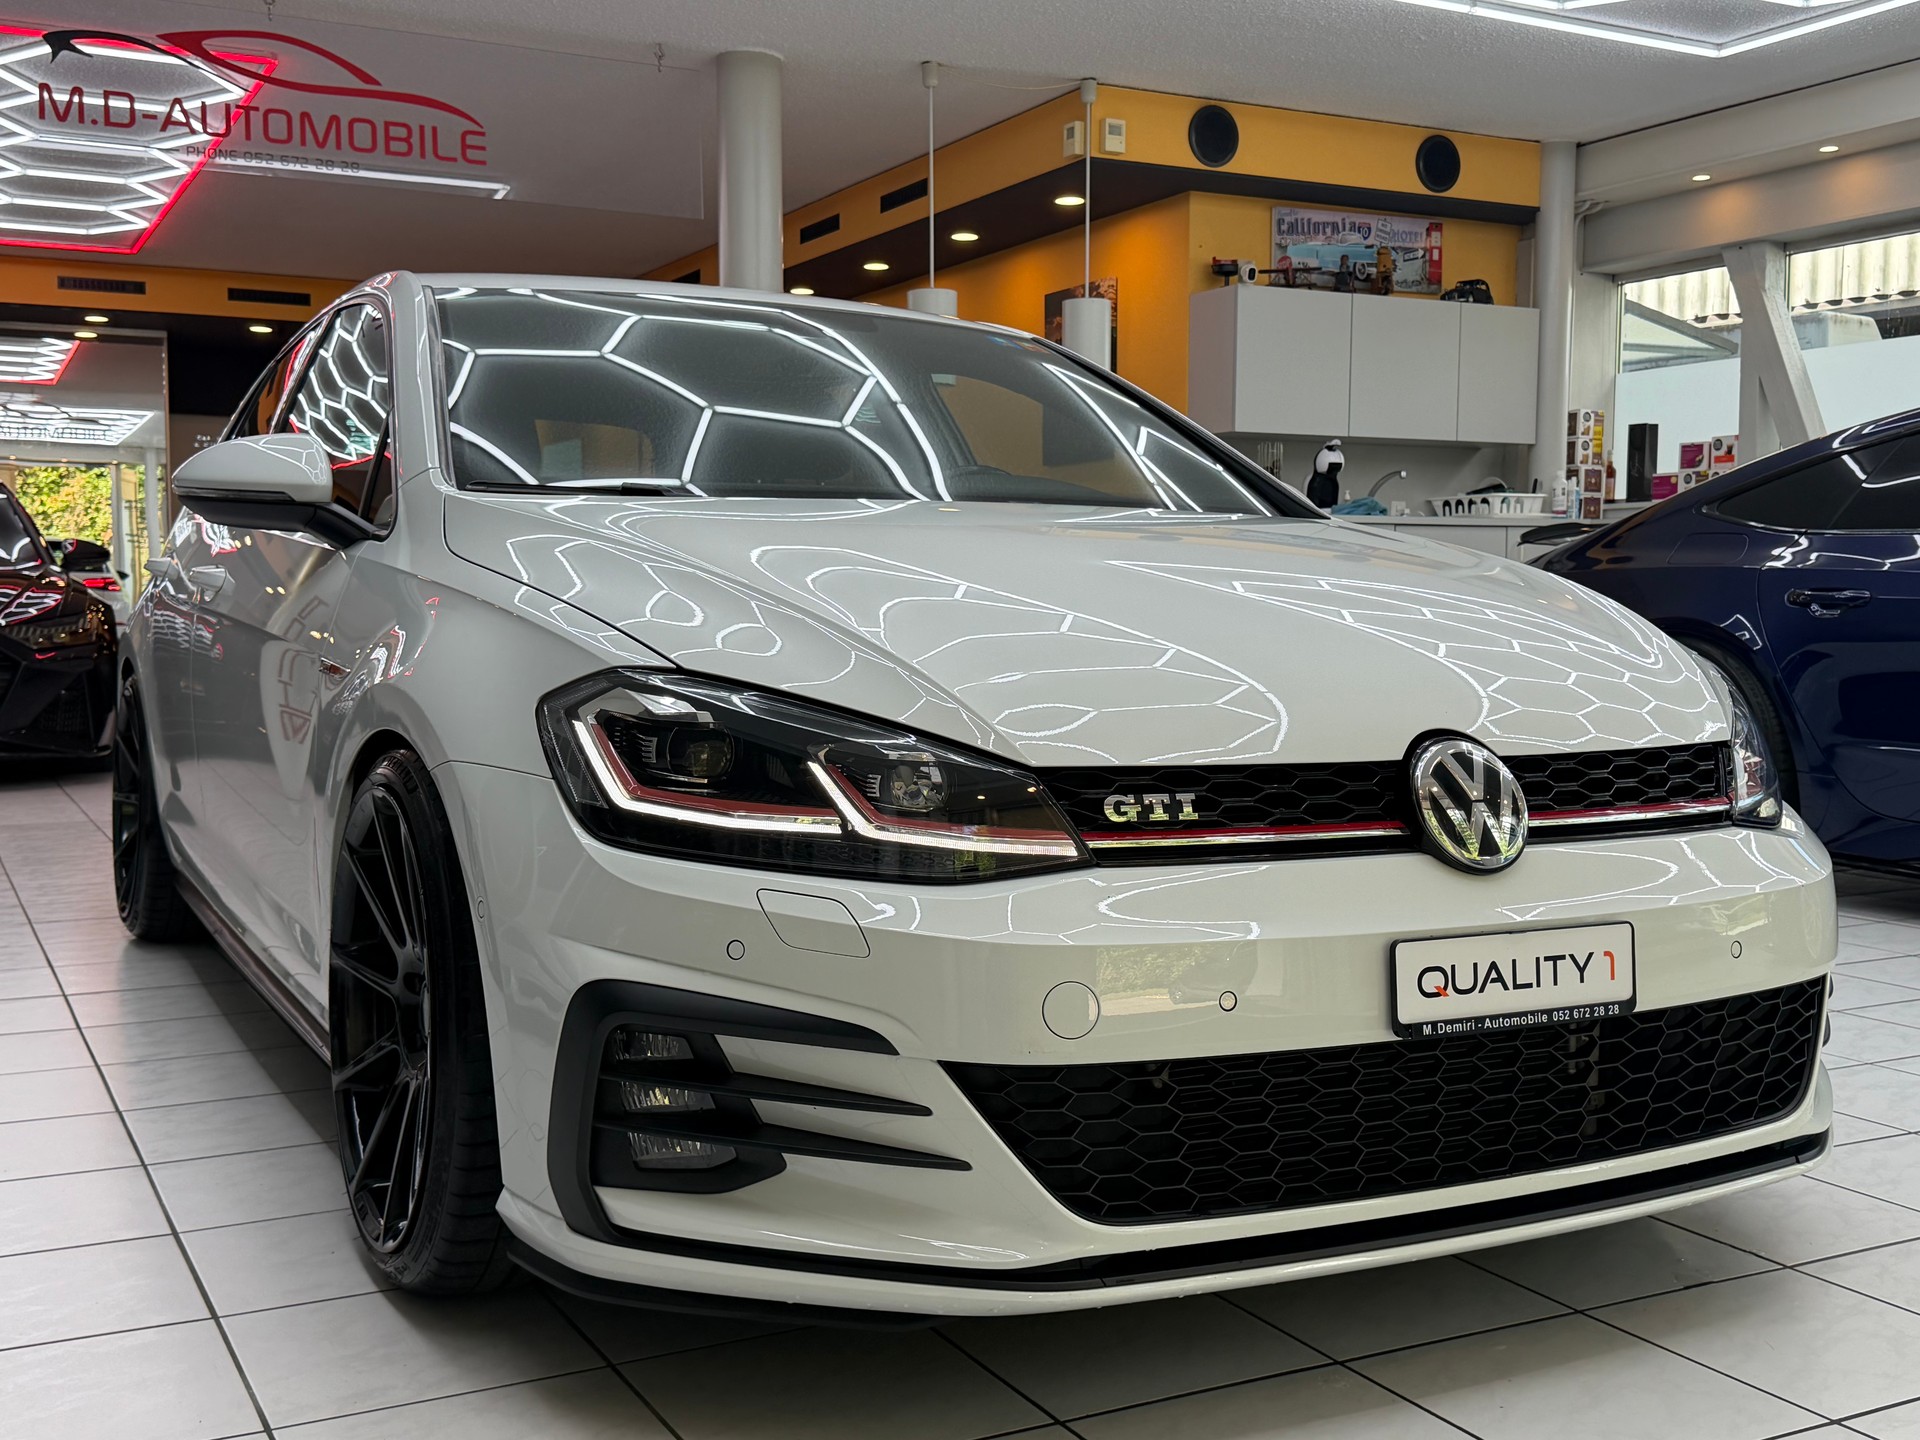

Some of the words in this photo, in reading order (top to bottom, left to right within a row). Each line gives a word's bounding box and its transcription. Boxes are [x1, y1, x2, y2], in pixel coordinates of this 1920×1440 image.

[187, 146, 239, 162] PHONE
[243, 151, 274, 164] 052
[280, 155, 308, 168] 672
[315, 158, 335, 172] 28
[341, 161, 360, 174] 28
[1277, 217, 1357, 236] California
[1103, 793, 1199, 823] GTI
[1417, 951, 1595, 999] QUALITY
[1484, 1012, 1548, 1030] Automobile
[1552, 1010, 1570, 1022] 052
[1573, 1007, 1591, 1019] 672
[1593, 1005, 1605, 1017] 28
[1608, 1004, 1620, 1015] 28
